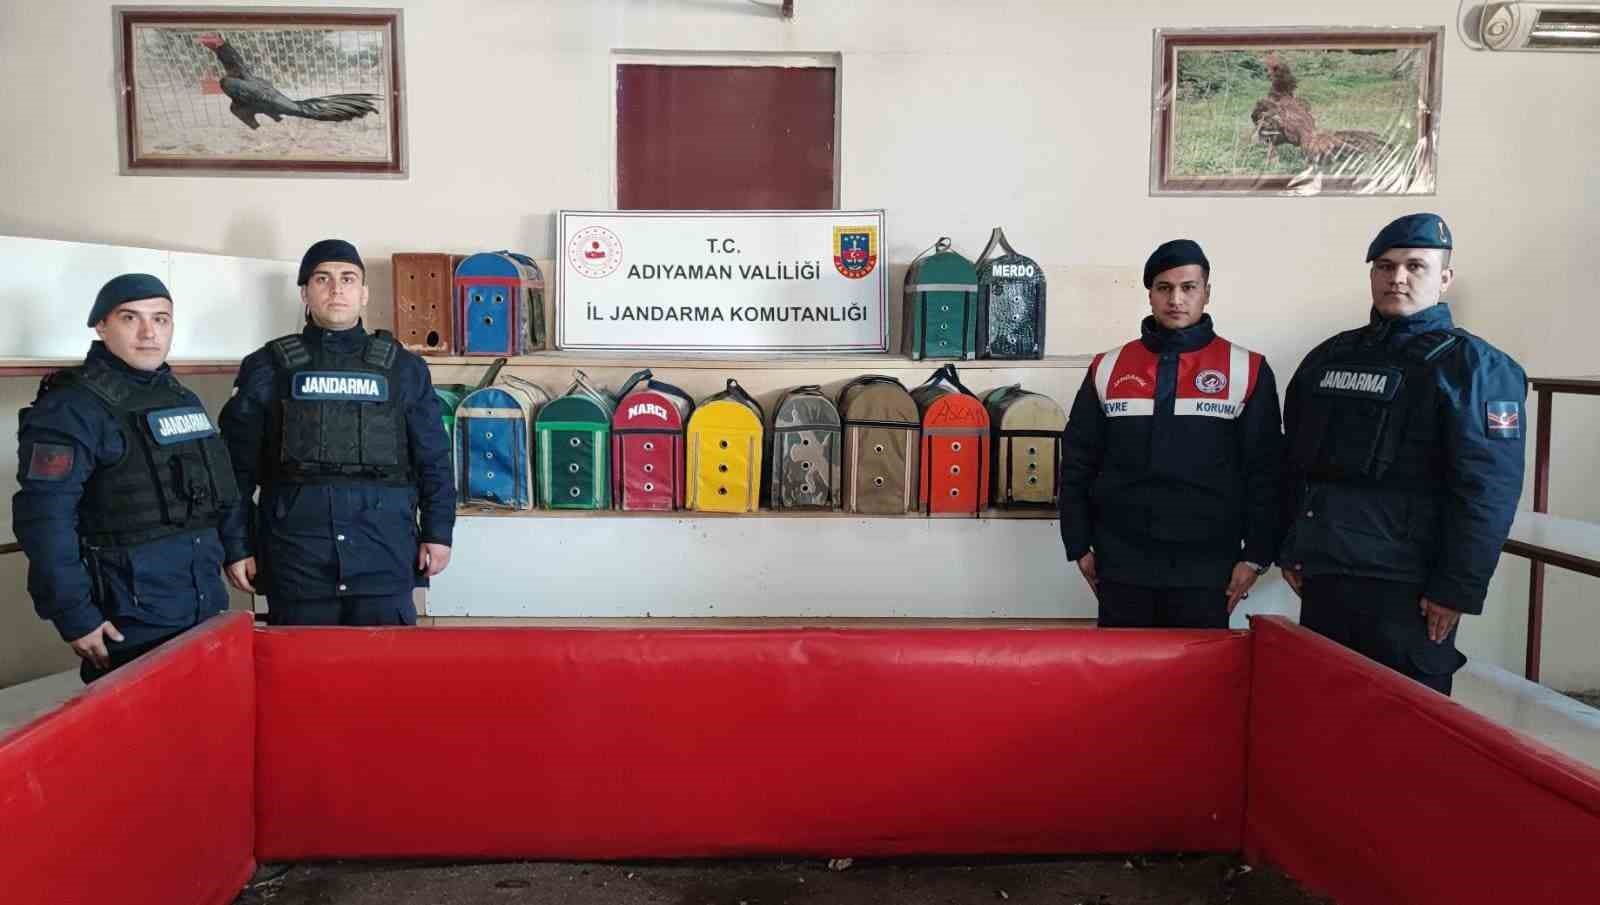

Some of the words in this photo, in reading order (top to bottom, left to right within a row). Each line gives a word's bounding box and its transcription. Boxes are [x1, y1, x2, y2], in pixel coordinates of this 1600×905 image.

[707, 238, 741, 254] T.C.
[627, 264, 732, 280] ADIYAMAN
[738, 260, 821, 280] VALİLİĞİ
[992, 264, 1034, 277] MERDO
[586, 301, 604, 321] İL
[610, 305, 725, 321] JANDARMA
[731, 302, 868, 321] KOMUTANLIĞI
[302, 376, 379, 396] JANDARMA
[1320, 370, 1388, 393] JANDARMA
[159, 412, 214, 436] JANDARMA
